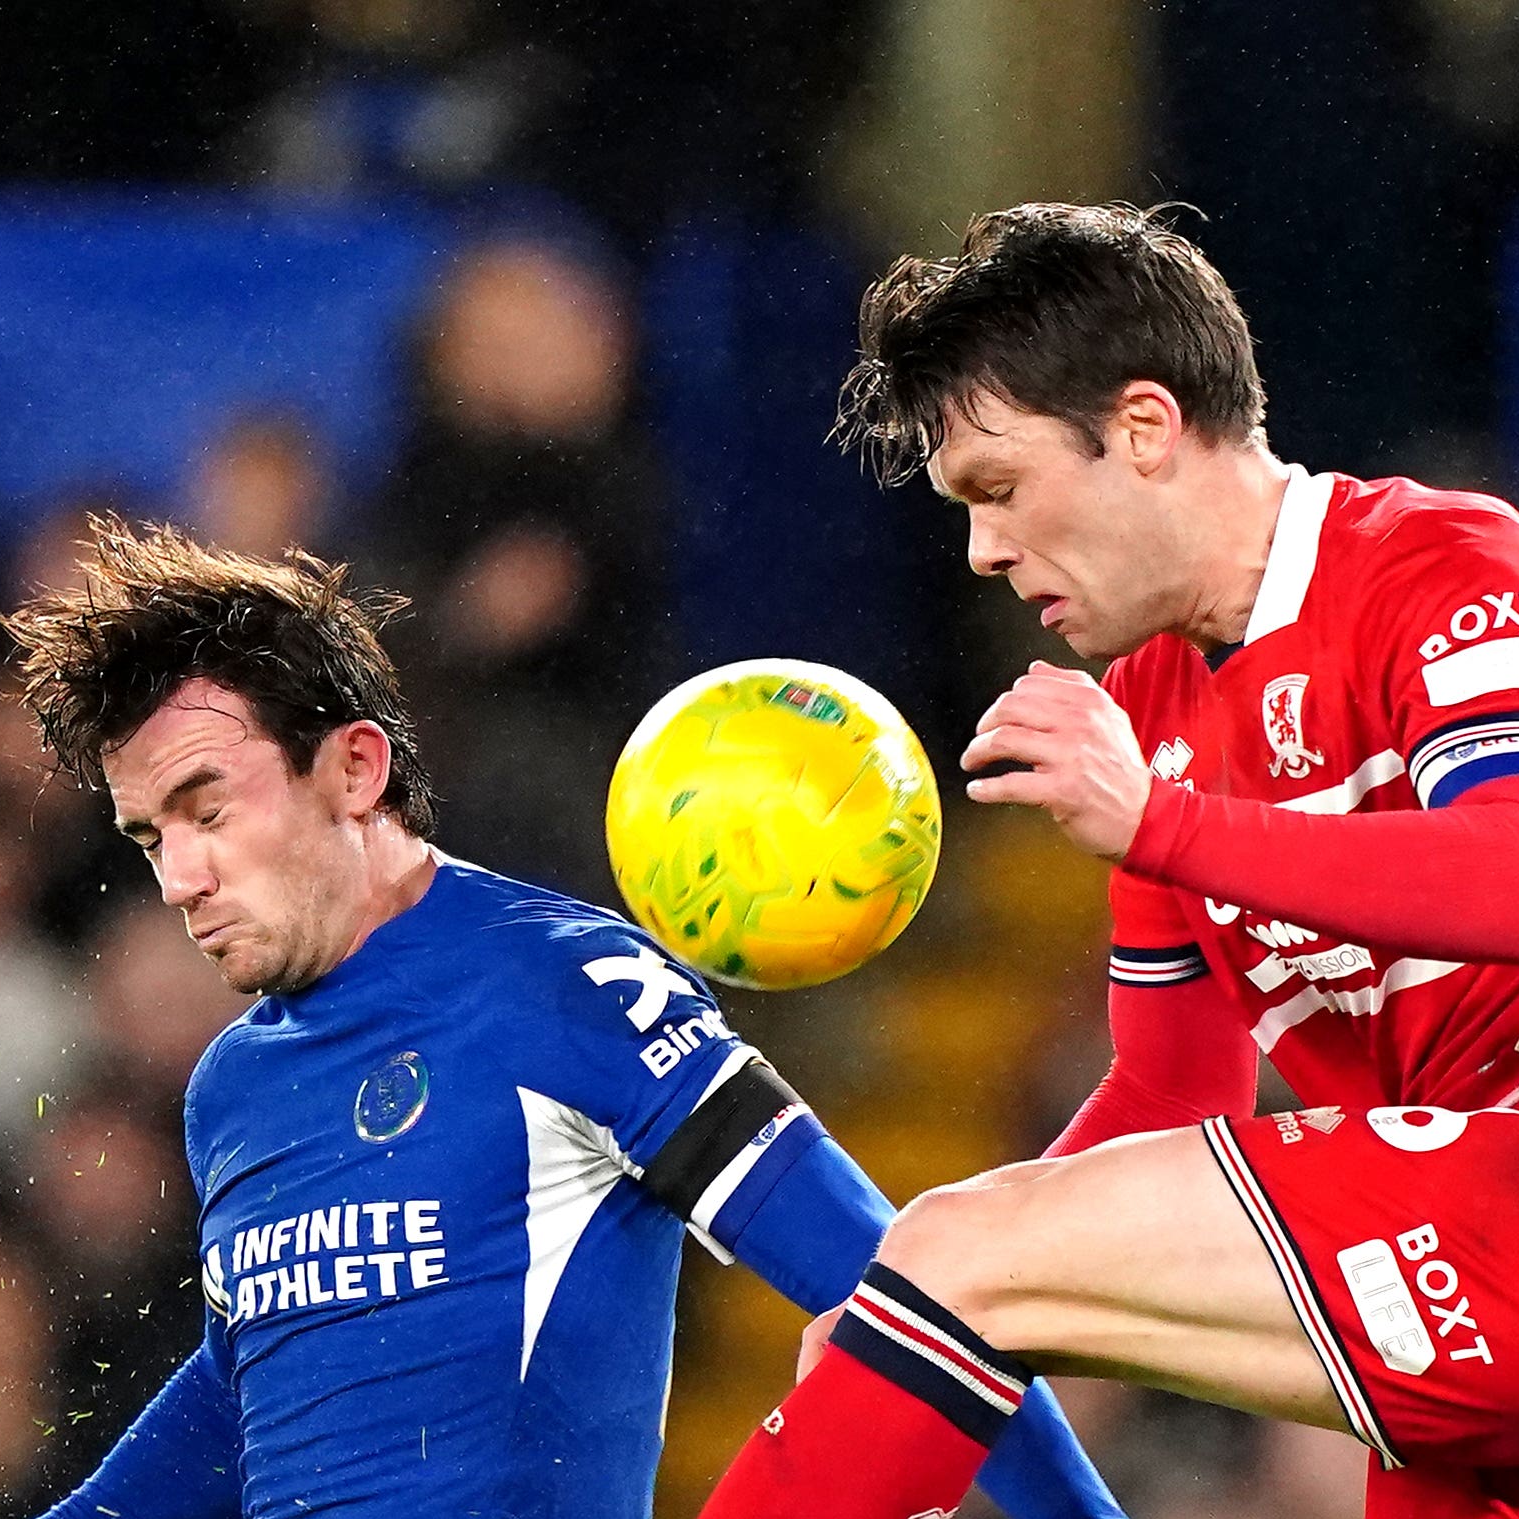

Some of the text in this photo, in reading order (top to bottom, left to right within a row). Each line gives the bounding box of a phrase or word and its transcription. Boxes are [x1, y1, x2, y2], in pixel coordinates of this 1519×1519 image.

[232, 1200, 444, 1274] INFINITE
[232, 1248, 450, 1322] ATHLETE
[1350, 1256, 1423, 1357] LIFE
[1395, 1223, 1494, 1365] BOXT
